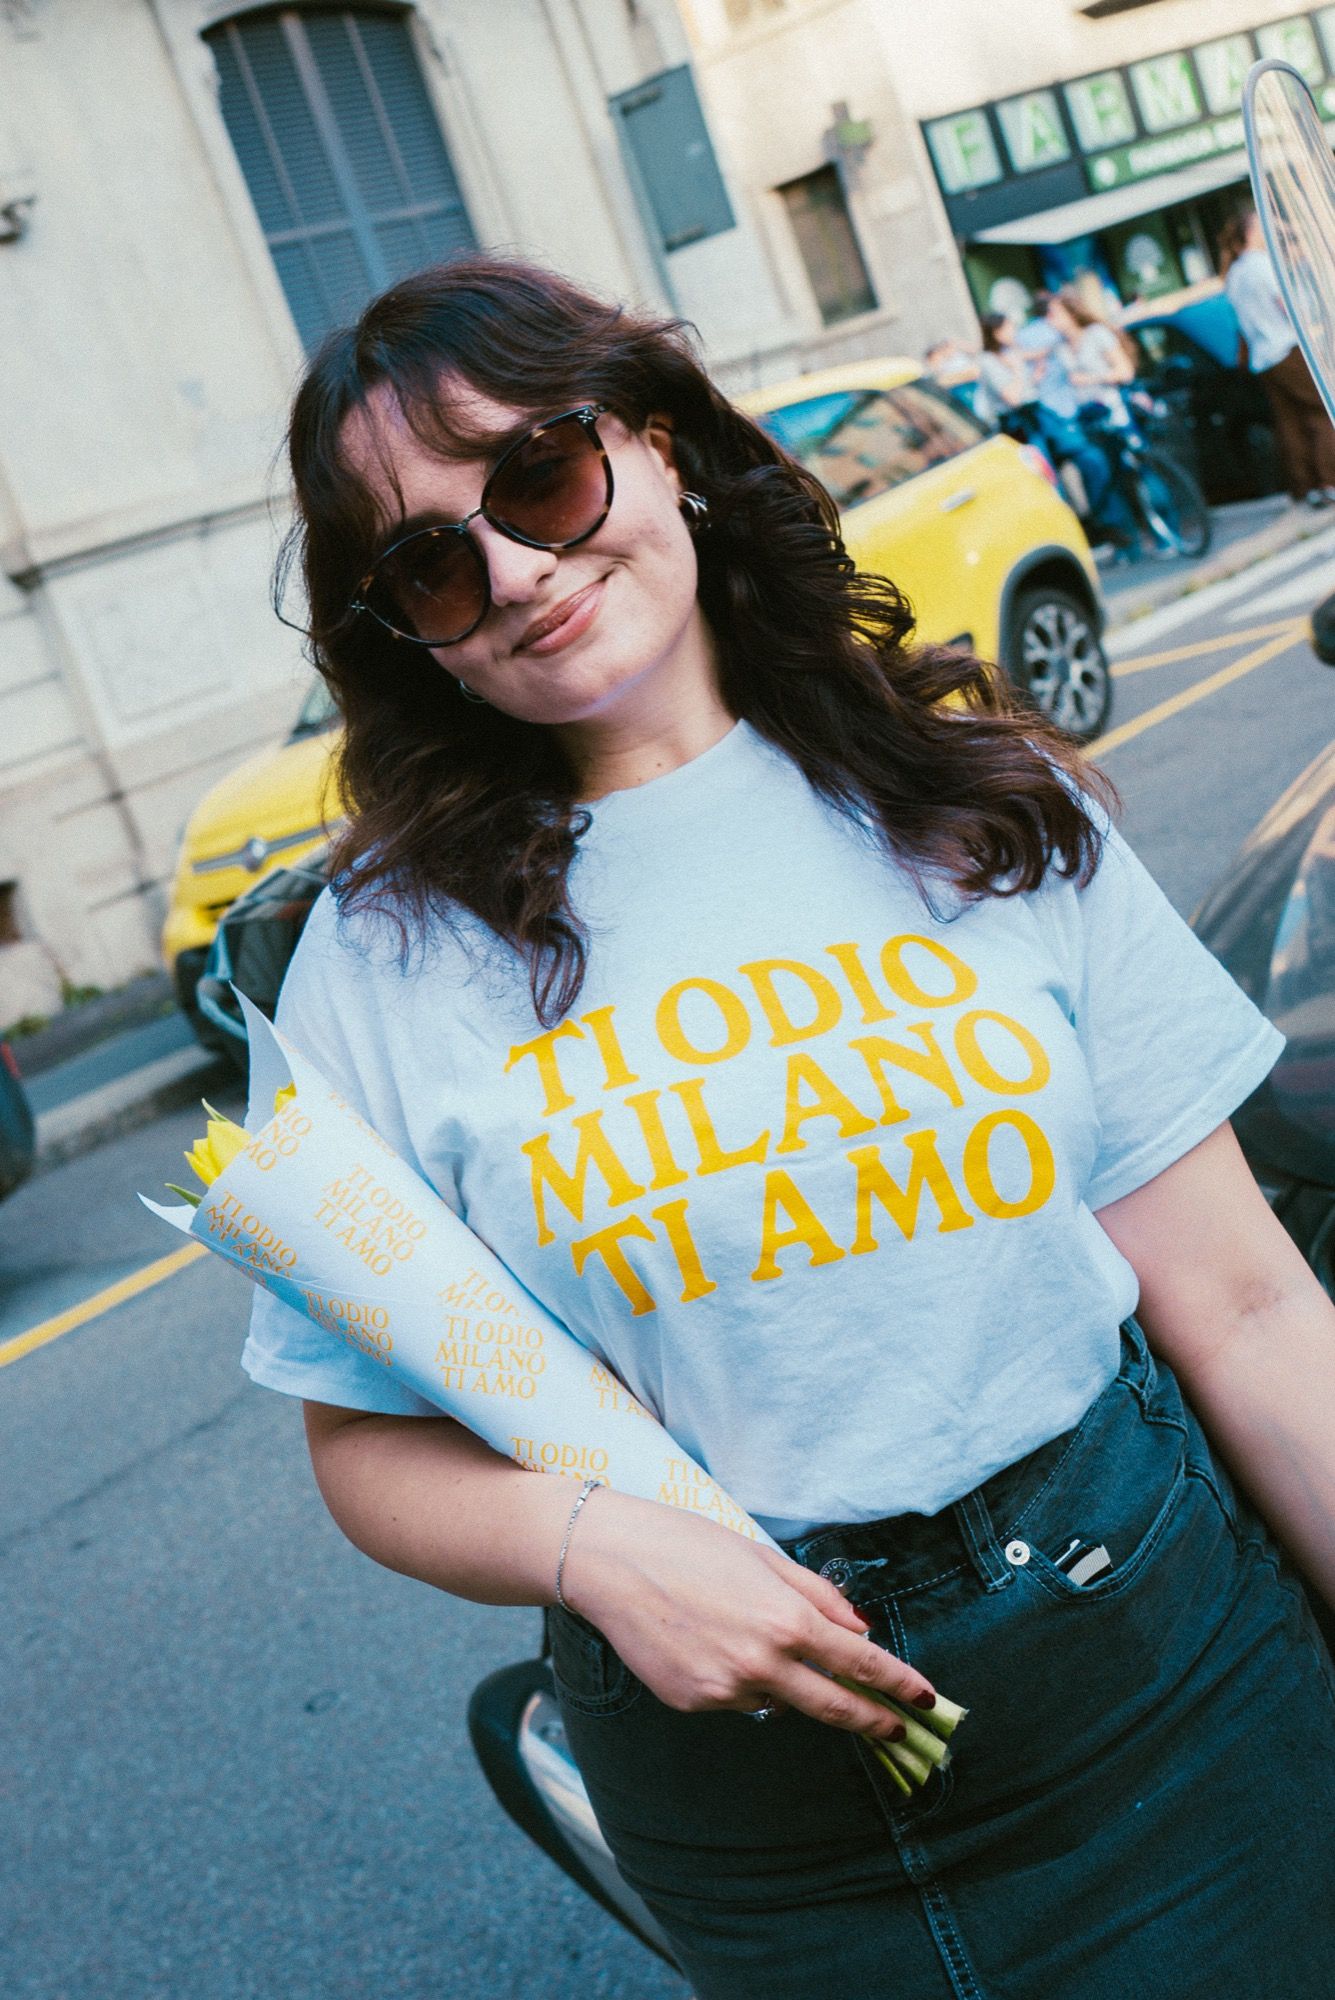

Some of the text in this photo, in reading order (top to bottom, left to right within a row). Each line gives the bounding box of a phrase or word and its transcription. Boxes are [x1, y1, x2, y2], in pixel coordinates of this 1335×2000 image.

[504, 934, 978, 1117] TI ODIO
[521, 1010, 1051, 1247] MILANO
[223, 1189, 245, 1219] TI
[241, 1214, 298, 1268] ODIO
[314, 1197, 393, 1276] TI AMO
[321, 1178, 416, 1262] MILANO
[369, 1186, 428, 1240] ODIO
[570, 1109, 1056, 1316] TI AMO
[328, 1299, 390, 1329] ODIO
[446, 1314, 545, 1350] TI ODIO
[434, 1341, 547, 1375] MILANO
[441, 1365, 538, 1400] TI AMO
[510, 1436, 535, 1461] TI
[540, 1441, 610, 1473] ODIO
